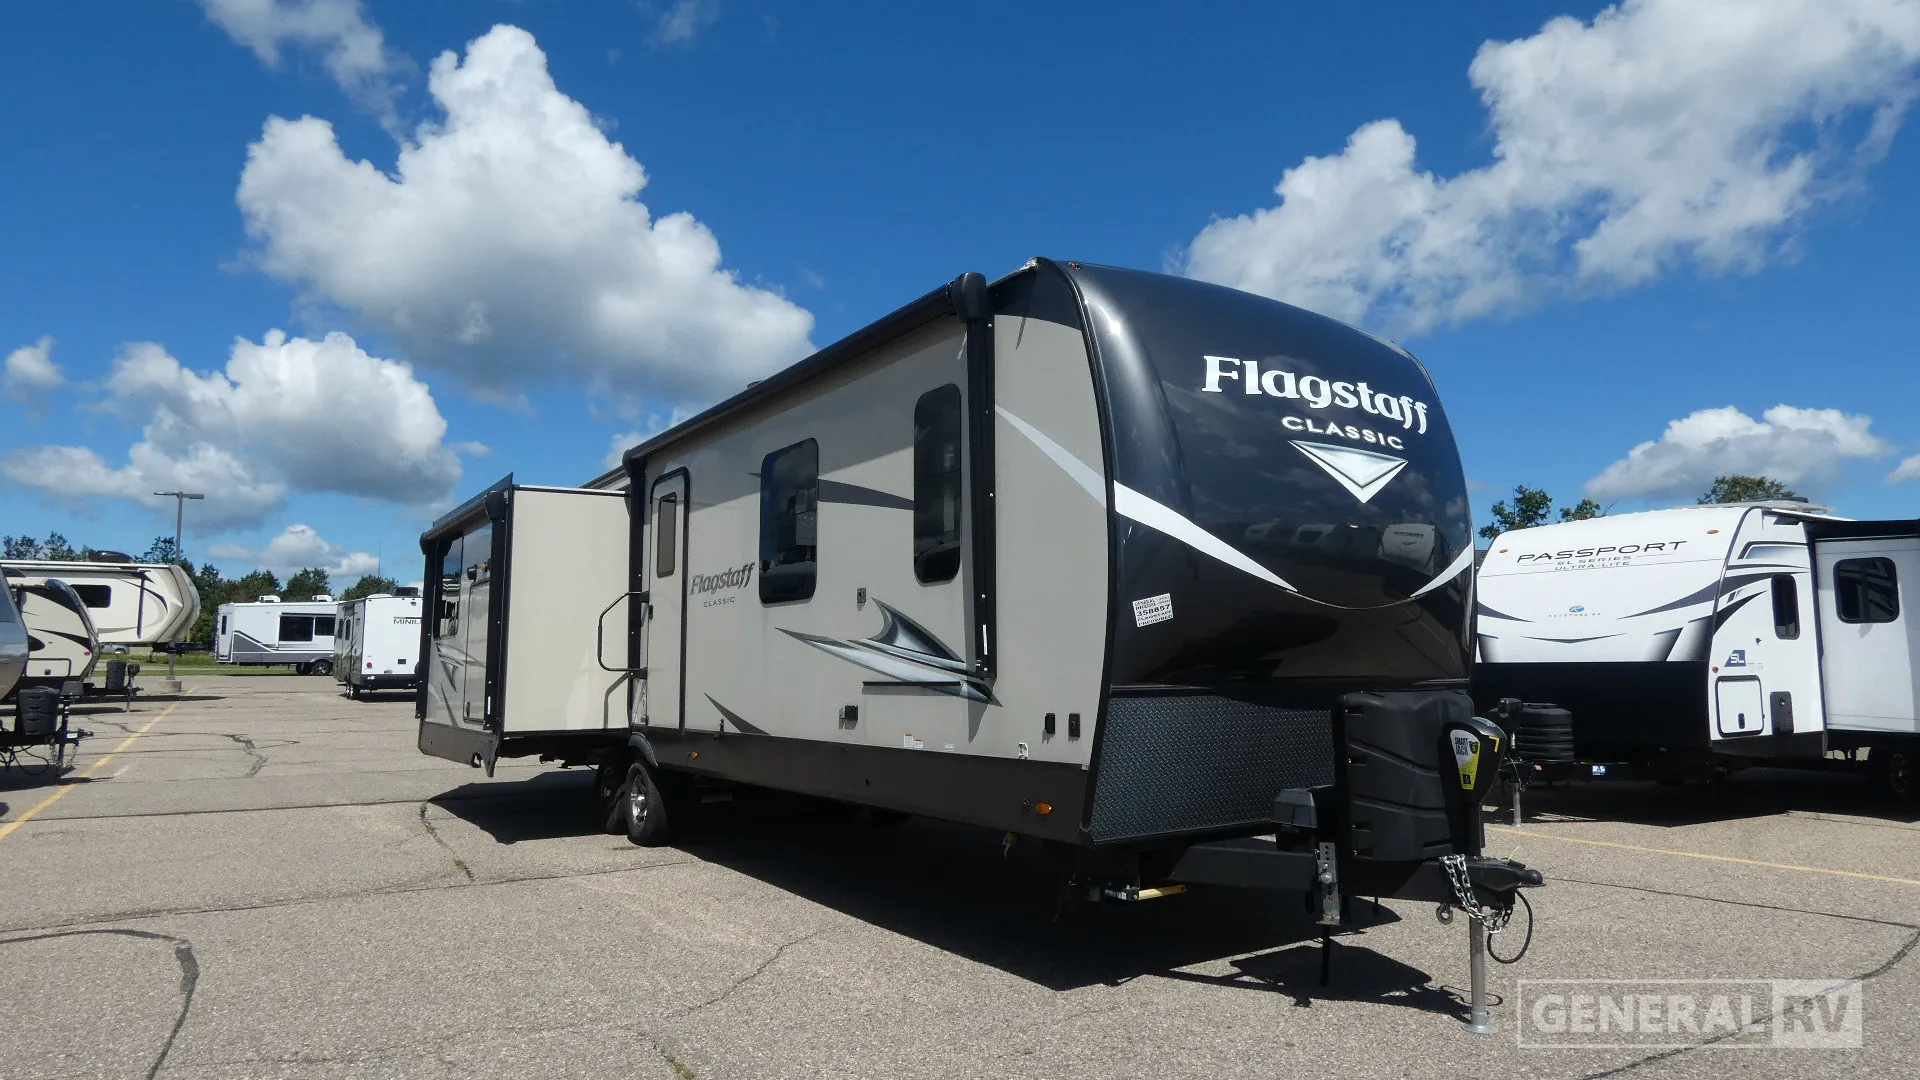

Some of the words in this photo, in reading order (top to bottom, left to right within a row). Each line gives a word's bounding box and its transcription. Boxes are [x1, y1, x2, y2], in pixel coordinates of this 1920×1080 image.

[1202, 355, 1427, 435] Flagstaff
[1281, 416, 1405, 450] CLASSIC
[1517, 540, 1688, 563] PASSPORT
[1578, 555, 1632, 564] SERIES
[1555, 561, 1631, 571] ULTRA-LITE
[690, 562, 756, 595] Flagstaff
[703, 596, 736, 608] CLASSIC
[1730, 653, 1745, 664] SL
